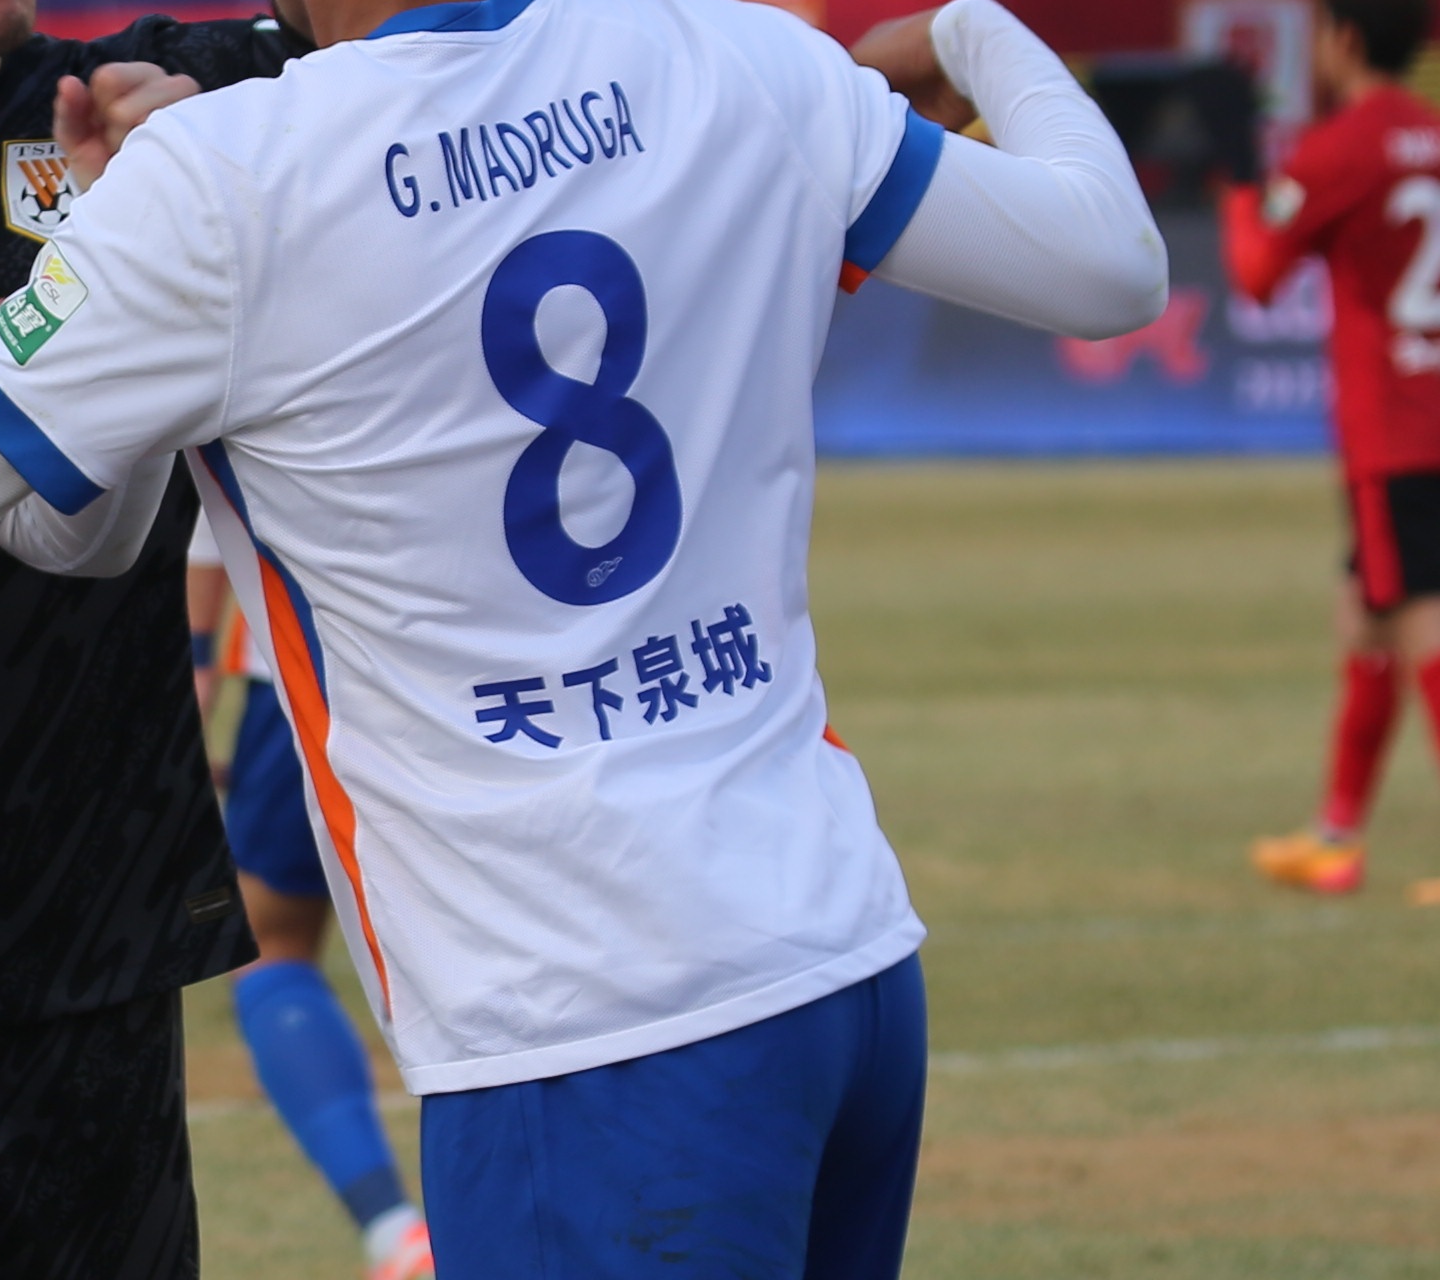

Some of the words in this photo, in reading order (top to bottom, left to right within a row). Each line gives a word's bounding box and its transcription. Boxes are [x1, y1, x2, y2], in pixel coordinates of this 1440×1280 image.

[384, 80, 645, 218] G.MADRUGA
[41, 281, 62, 306] CSL
[481, 228, 683, 606] 8
[474, 602, 773, 750] 天下泉城
